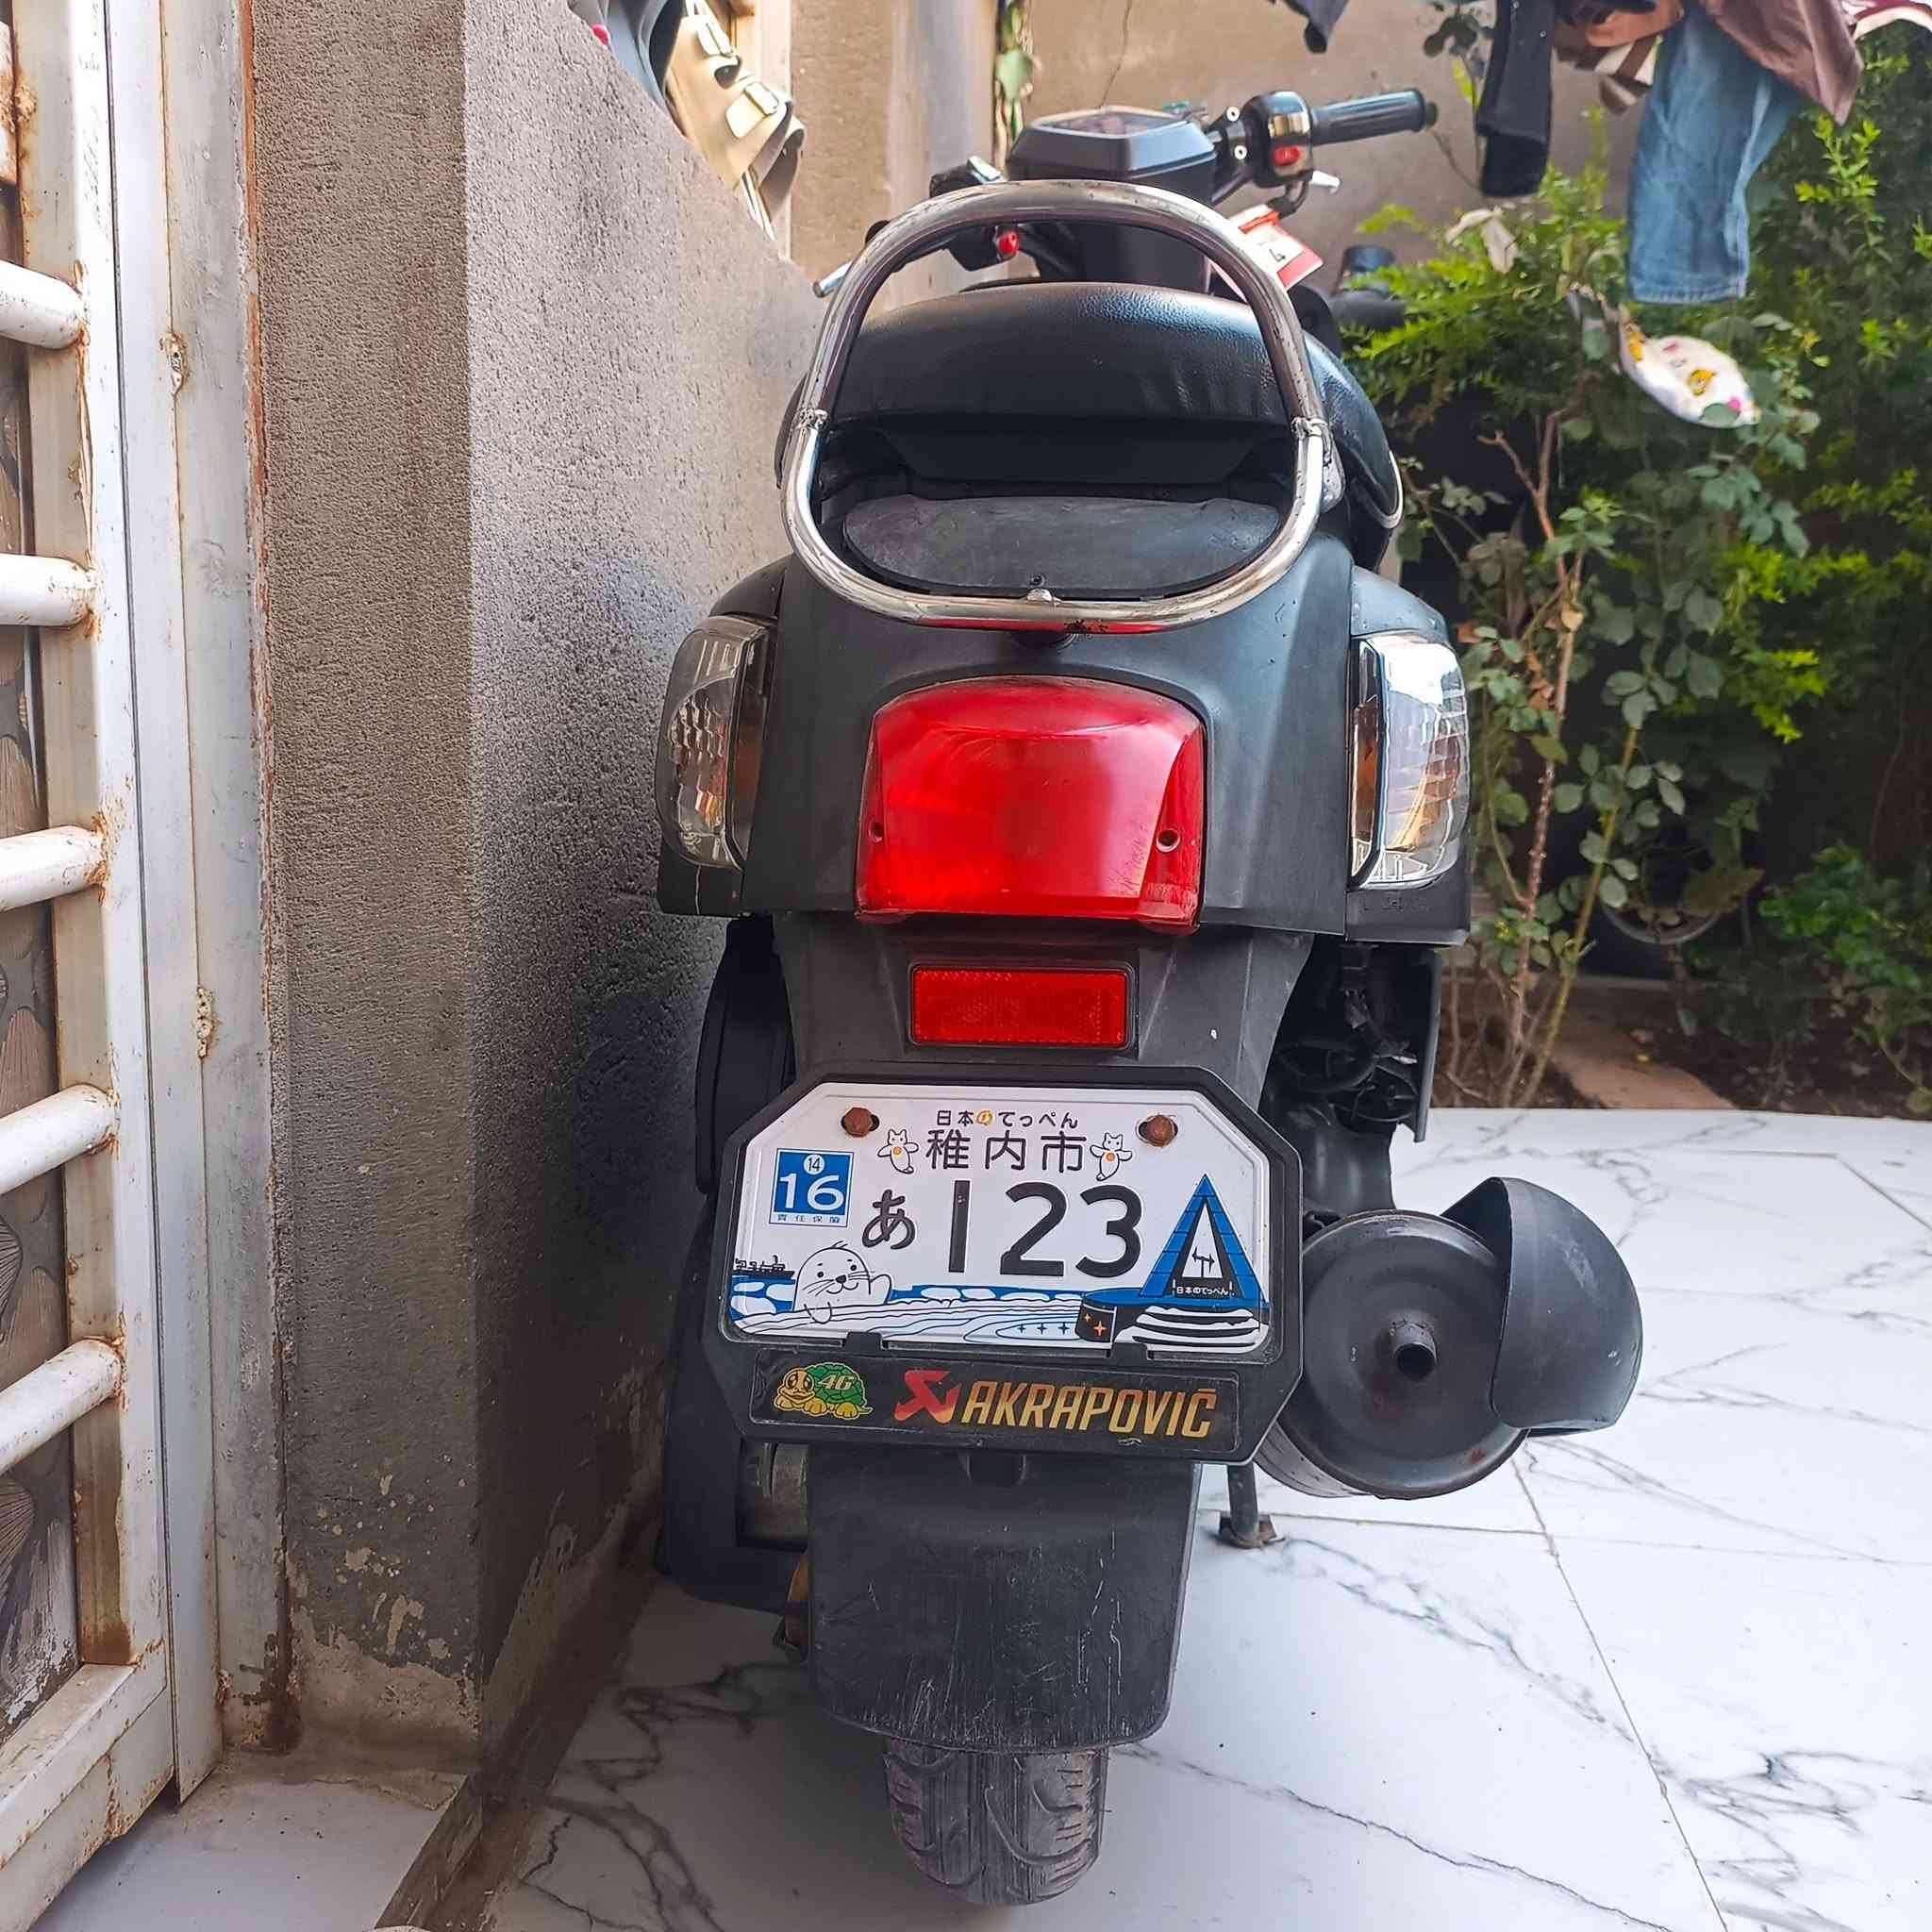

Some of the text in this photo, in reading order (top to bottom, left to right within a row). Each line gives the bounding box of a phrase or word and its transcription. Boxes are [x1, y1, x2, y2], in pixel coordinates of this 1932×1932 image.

[807, 1158, 821, 1172] 14
[925, 1129, 1087, 1174] 稚内市
[779, 1173, 844, 1211] 16
[861, 1180, 1142, 1277] あ 123
